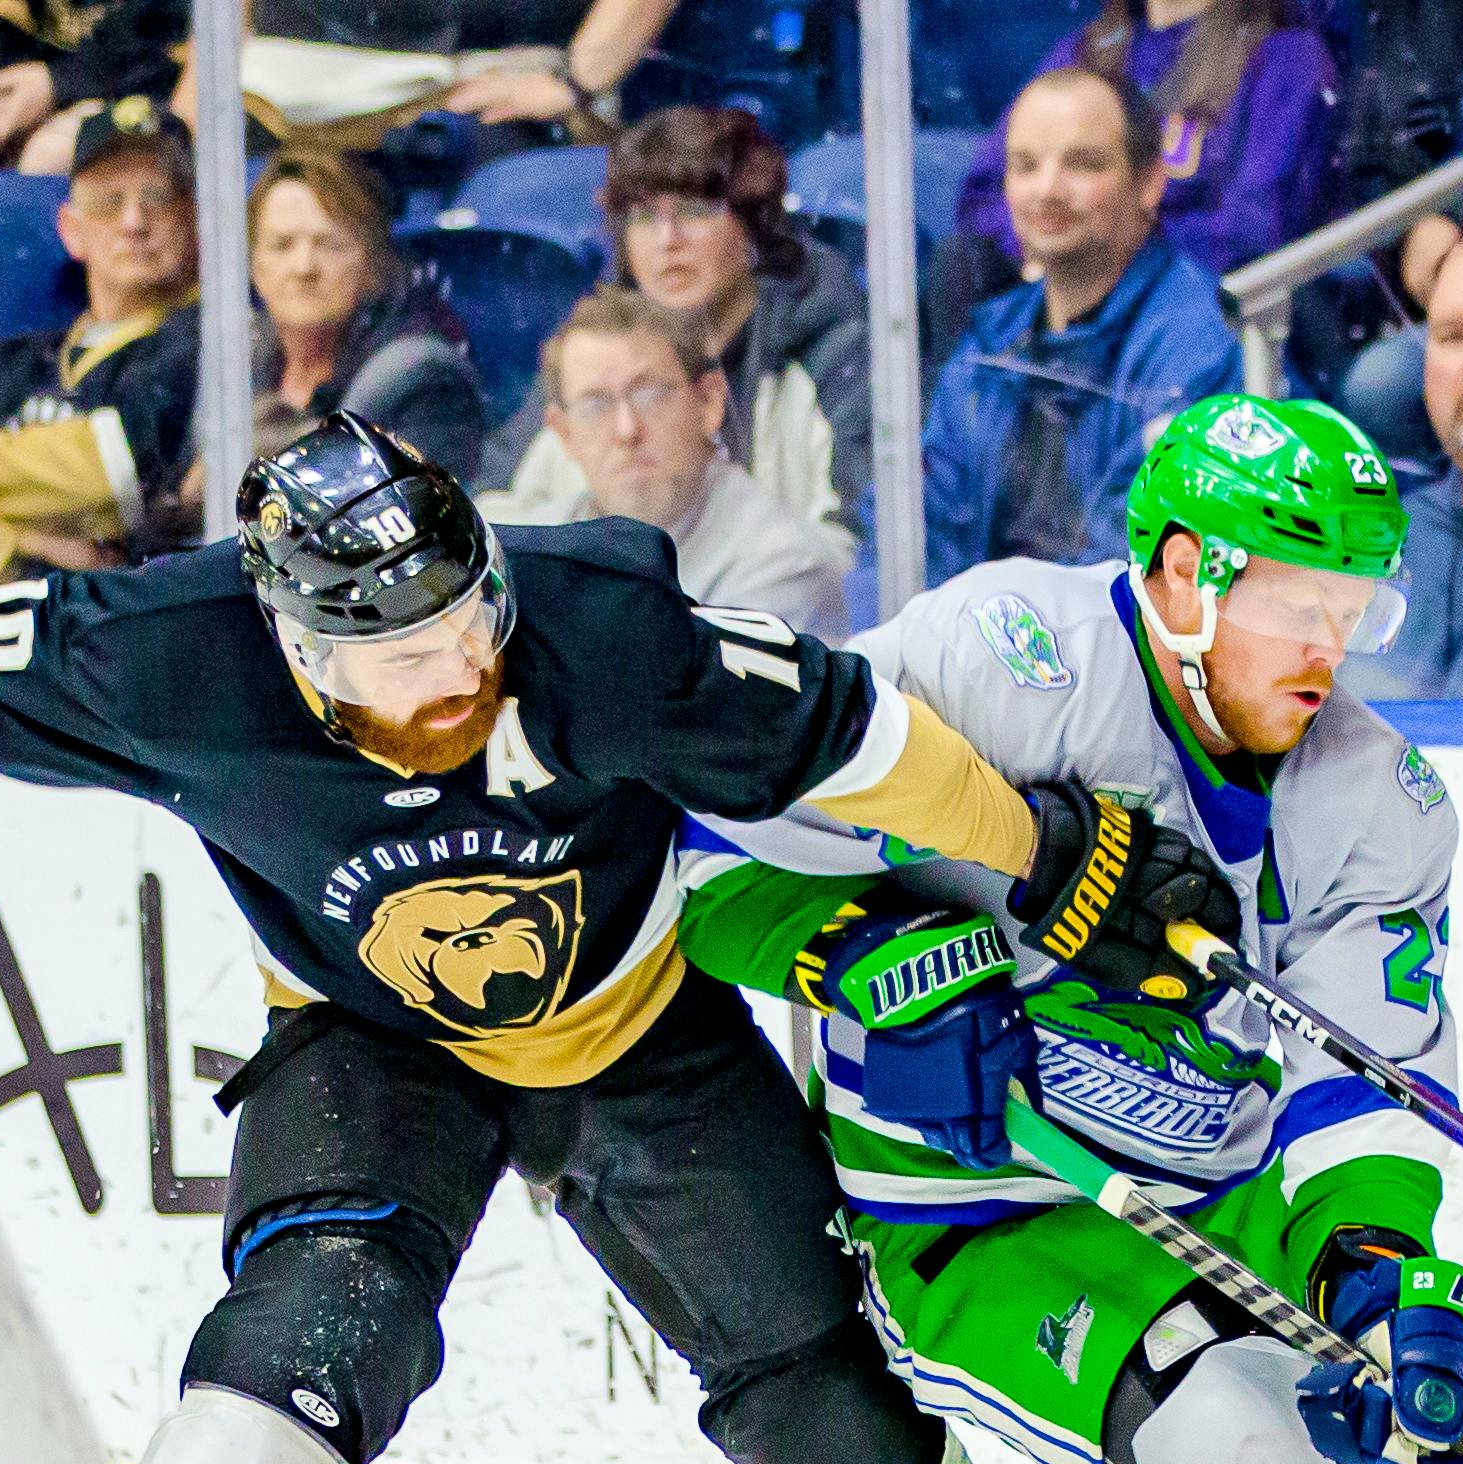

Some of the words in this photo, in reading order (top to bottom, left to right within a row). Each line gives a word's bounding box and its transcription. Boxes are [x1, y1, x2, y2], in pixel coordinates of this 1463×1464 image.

[1344, 451, 1388, 485] 23
[359, 505, 417, 551] 10
[690, 606, 802, 693] 10
[487, 696, 556, 798] A
[1245, 980, 1330, 1050] CCM
[1413, 1271, 1435, 1290] 23
